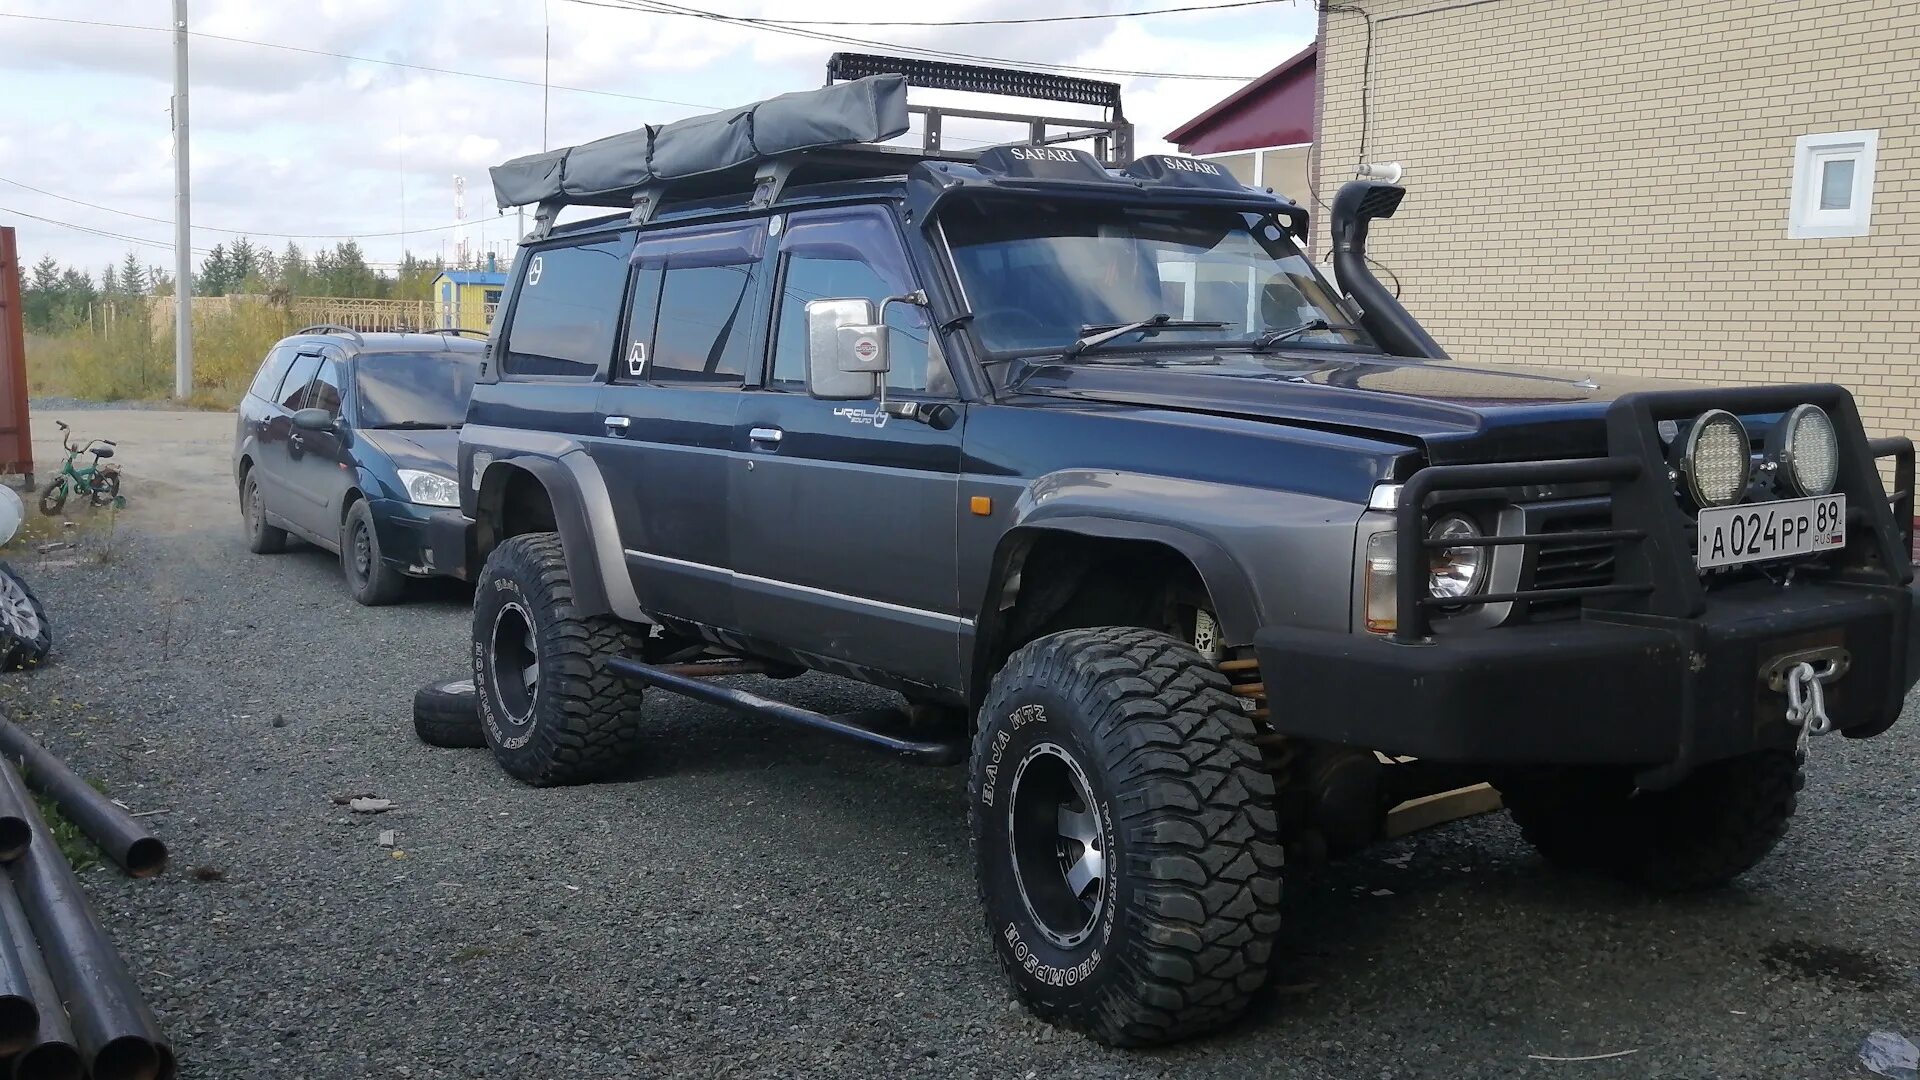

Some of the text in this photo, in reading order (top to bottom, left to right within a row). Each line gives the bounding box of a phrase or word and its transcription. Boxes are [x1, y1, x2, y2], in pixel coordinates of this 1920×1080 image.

[1010, 147, 1078, 163] SAFARI
[1163, 157, 1221, 176] SAFARI
[1816, 501, 1838, 533] 89
[1814, 533, 1831, 545] RUS
[982, 703, 1047, 806] BAJA MTZ
[1003, 921, 1101, 987] THOMPSON
